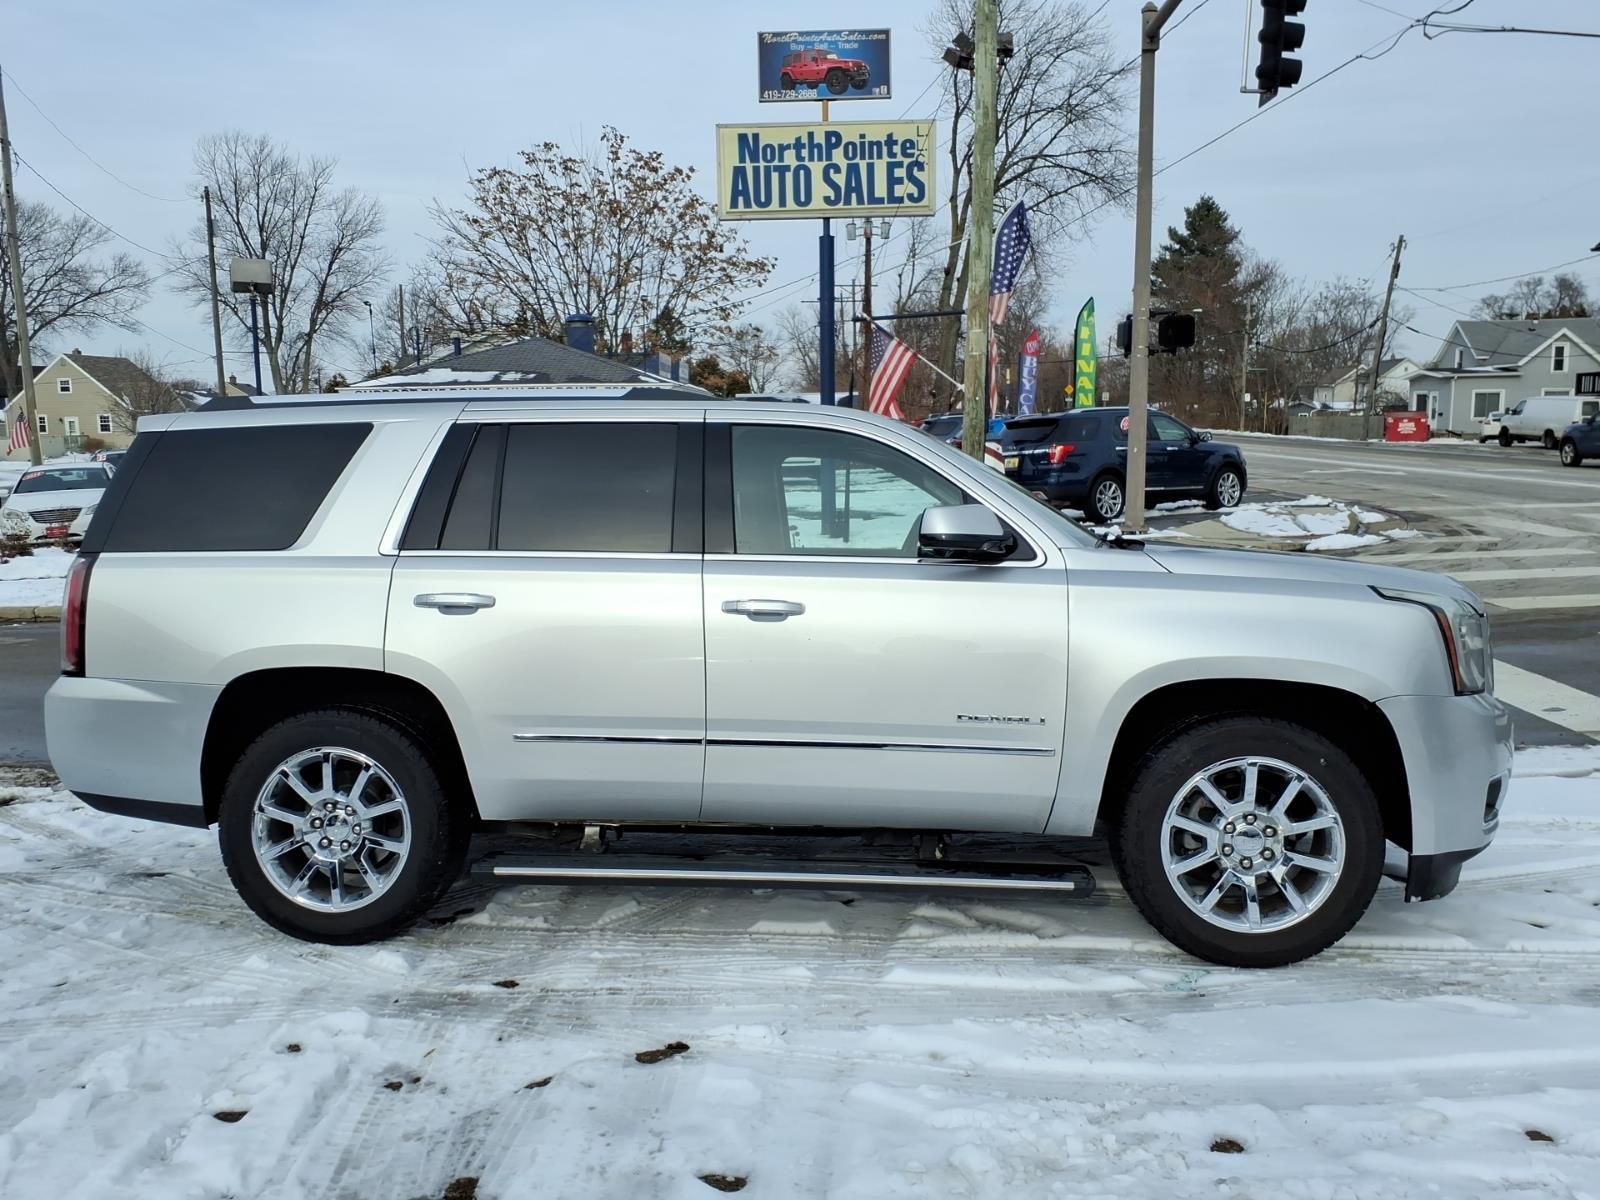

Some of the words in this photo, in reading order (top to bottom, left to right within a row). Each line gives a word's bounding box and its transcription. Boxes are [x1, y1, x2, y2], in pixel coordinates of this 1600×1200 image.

[762, 31, 887, 43] NorthPointeAutoSales.com
[790, 43, 804, 51] Buy
[814, 42, 828, 50] Sell
[838, 41, 859, 49] Trade
[737, 130, 916, 164] NorthPointe
[730, 163, 813, 210] AUTO
[822, 160, 926, 207] SALES
